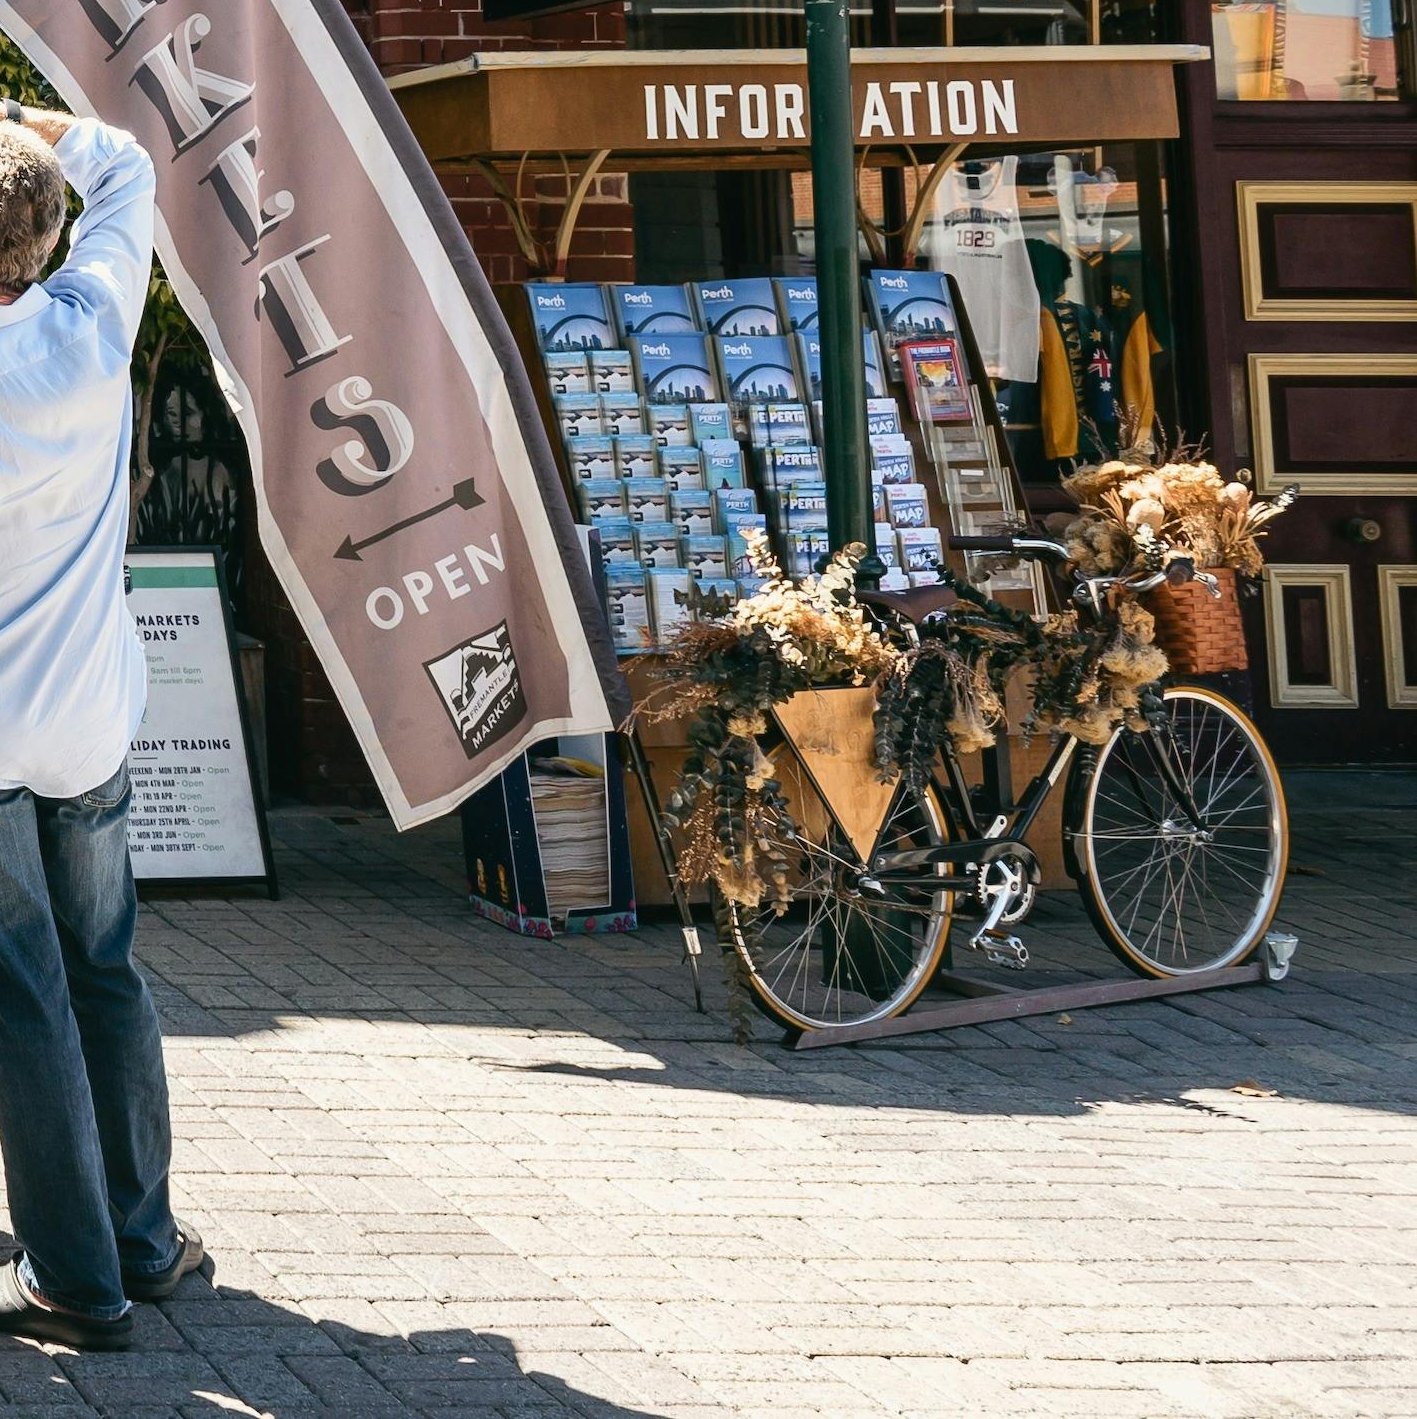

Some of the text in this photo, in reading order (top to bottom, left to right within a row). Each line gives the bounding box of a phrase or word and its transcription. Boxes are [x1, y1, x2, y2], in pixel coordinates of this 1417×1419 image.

[644, 79, 1020, 140] INFORATION
[957, 230, 996, 248] 1829
[880, 276, 908, 289] Perth
[624, 291, 652, 305] Perth
[702, 285, 734, 299] Perth
[537, 294, 565, 308] Perth
[642, 342, 670, 356] Perth
[723, 342, 752, 356] Perth
[869, 421, 894, 435] MAP
[881, 463, 909, 479] MAP
[895, 507, 924, 523] MAP
[364, 532, 507, 632] OPEN
[136, 615, 200, 627] MARKETS
[143, 630, 178, 641] DAYS
[469, 666, 510, 720] FREMANTLE
[471, 679, 521, 750] MARKETS
[131, 739, 231, 751] LIDAY TRADING
